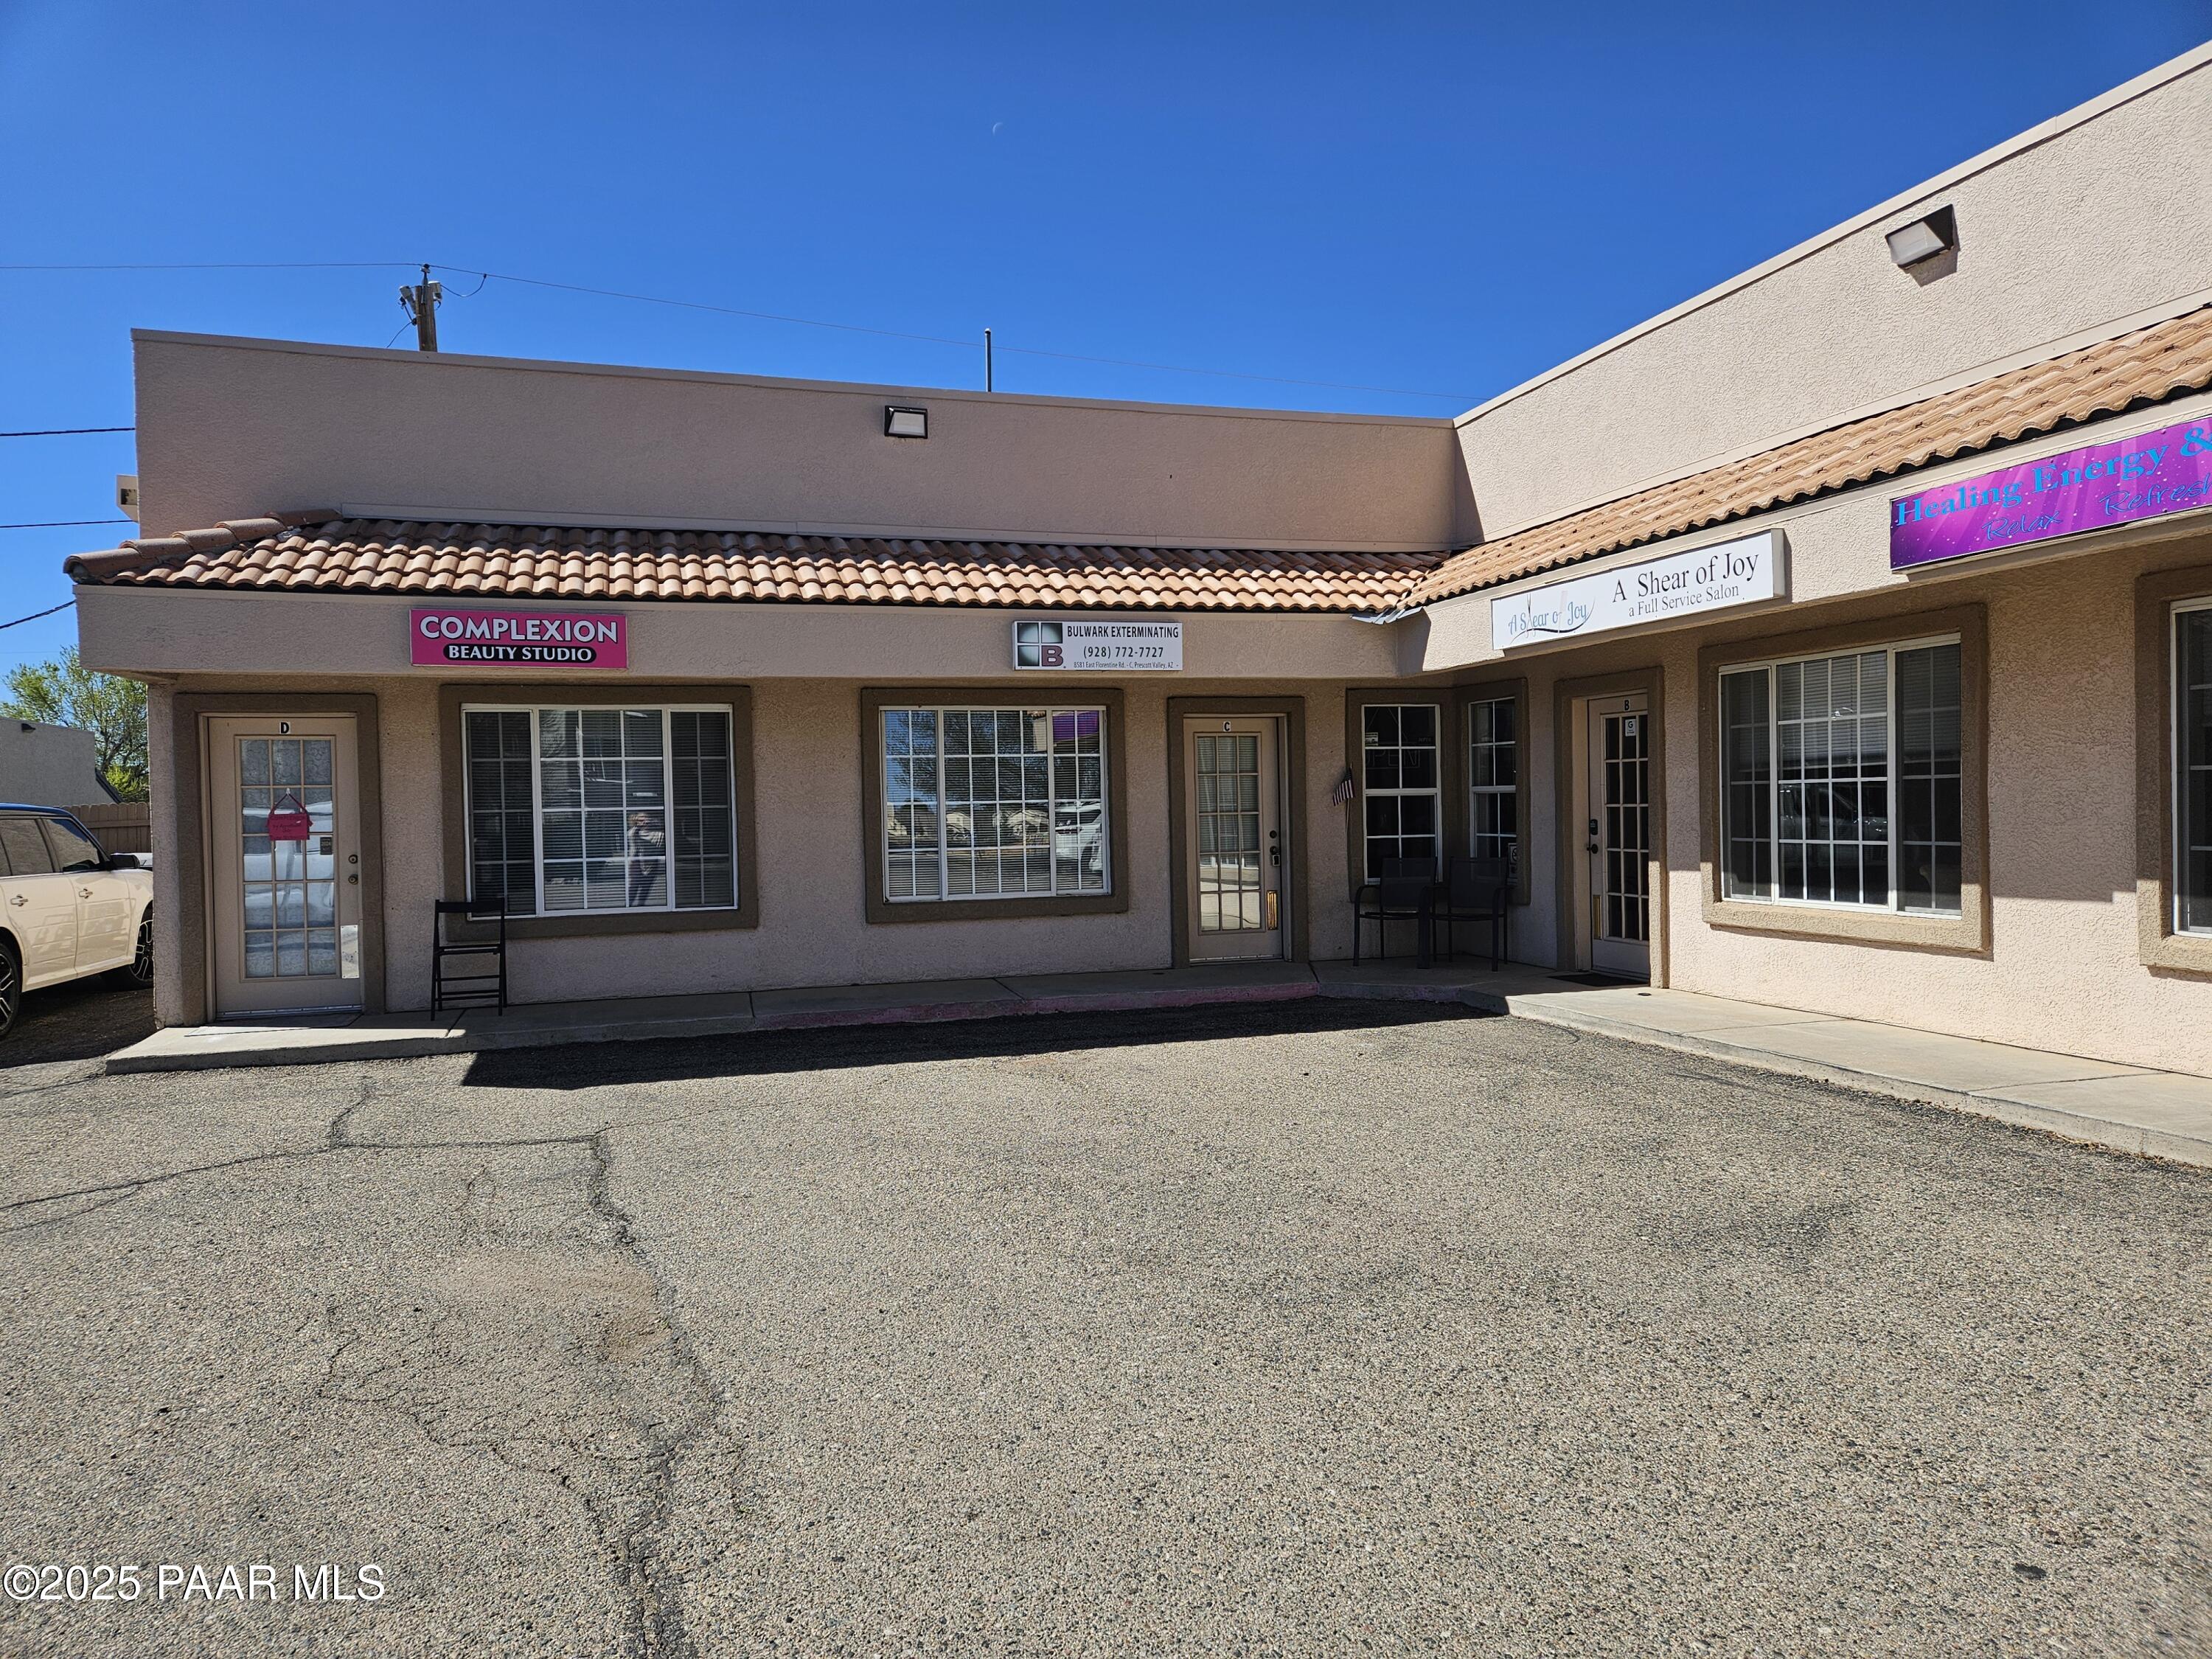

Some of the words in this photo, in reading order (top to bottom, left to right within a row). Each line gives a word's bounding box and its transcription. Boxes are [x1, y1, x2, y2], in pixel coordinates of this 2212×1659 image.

[1896, 481, 2023, 526] Healing
[2033, 445, 2168, 493] Energy
[2180, 427, 2212, 456] &
[1982, 510, 2063, 540] Relax
[1612, 579, 1627, 603] A
[1638, 569, 1689, 597] Shear
[1696, 556, 1718, 585] of
[1723, 553, 1759, 582] Joy
[1629, 607, 1635, 616] a
[1638, 598, 1658, 615] Full
[1662, 591, 1703, 611] Service
[1706, 584, 1739, 602] Salon
[1509, 614, 1517, 635] A
[1568, 602, 1587, 626] Joy
[420, 616, 618, 644] COMPLEXION
[1067, 626, 1109, 637] BULWARK
[1111, 627, 1179, 638] EXTERMINATING
[448, 645, 517, 660] BEAUTY
[522, 647, 592, 661] STUDIO
[1041, 645, 1063, 667] B
[1083, 646, 1111, 658] (928)
[1115, 647, 1164, 658] 772-7727
[1624, 700, 1630, 711] B
[280, 722, 290, 734] D
[1224, 722, 1230, 731] C
